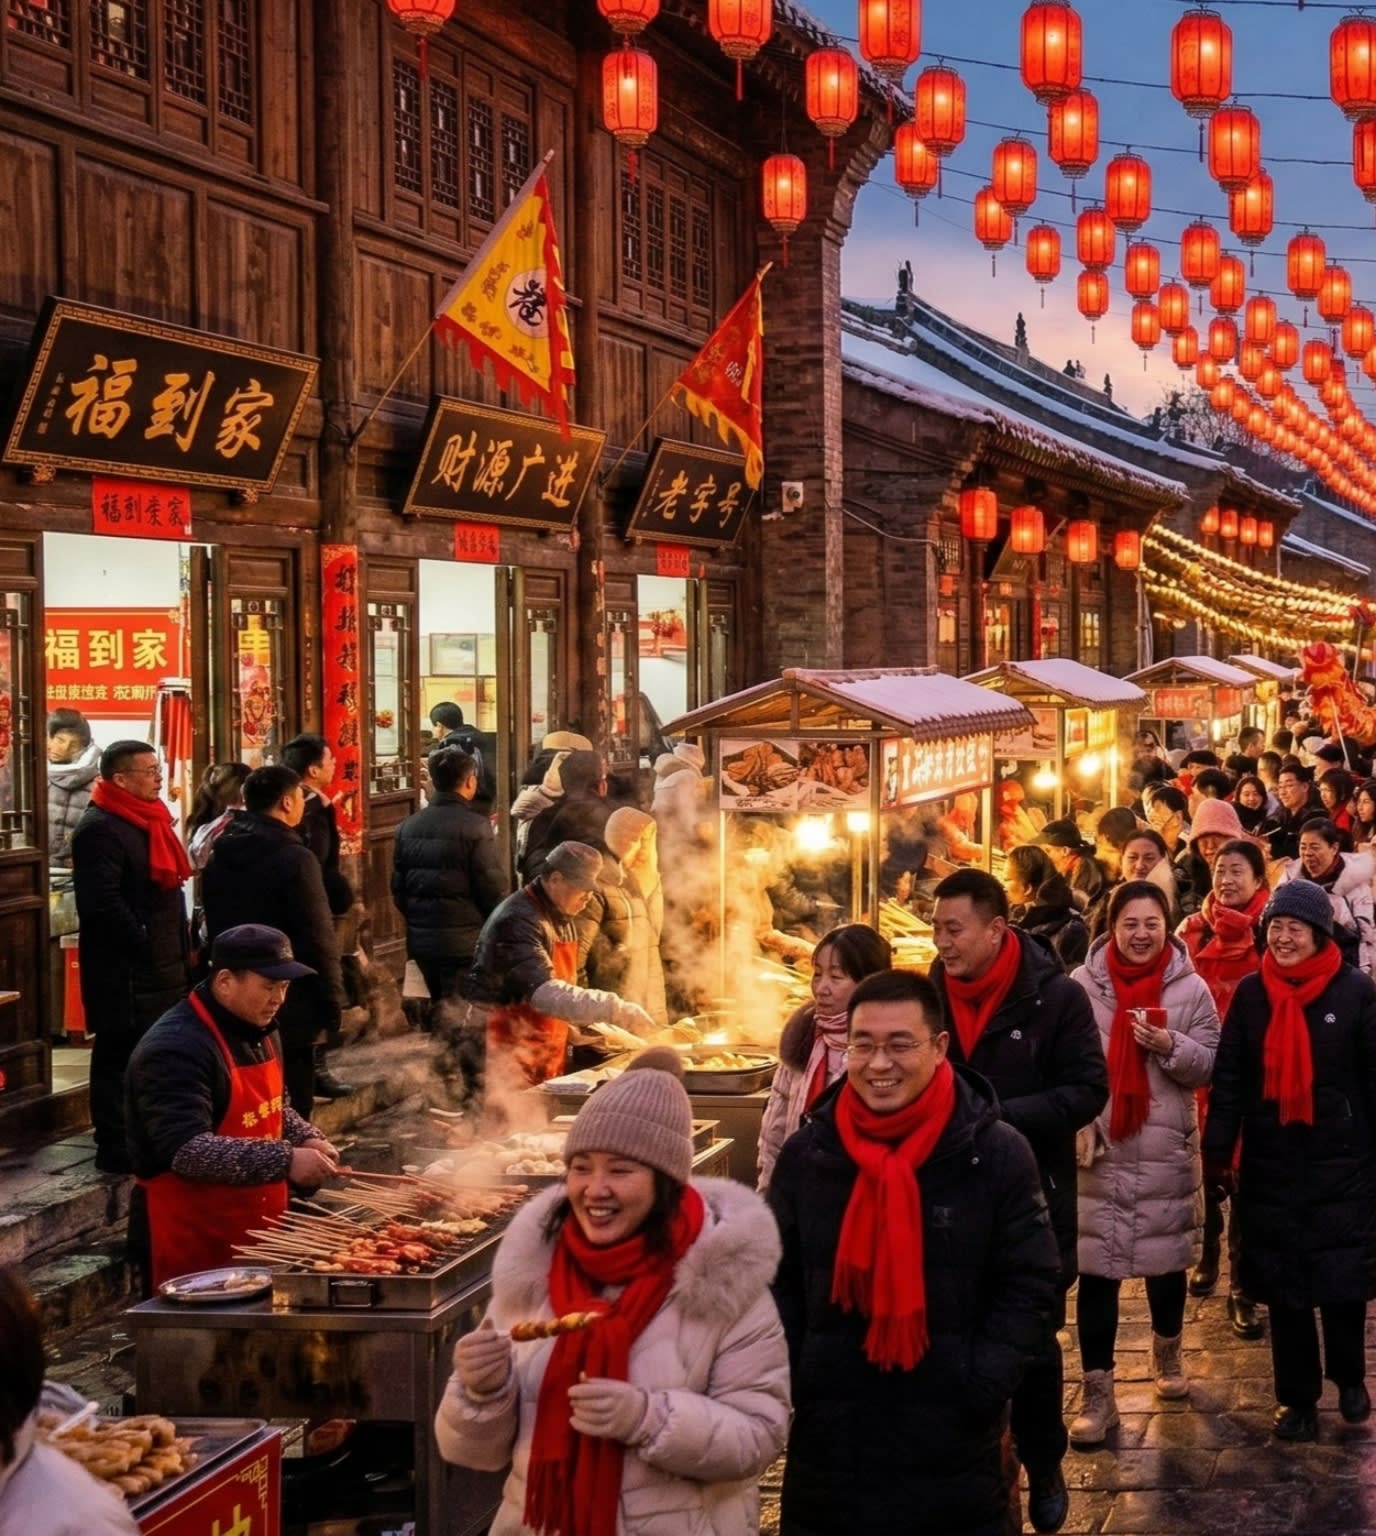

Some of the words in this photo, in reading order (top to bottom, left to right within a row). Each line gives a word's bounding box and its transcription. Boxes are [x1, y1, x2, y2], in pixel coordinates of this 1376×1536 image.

[66, 354, 275, 459] 福到家
[431, 430, 580, 508] 财源广进
[653, 469, 742, 529] 老字号
[45, 628, 169, 670] 福到家
